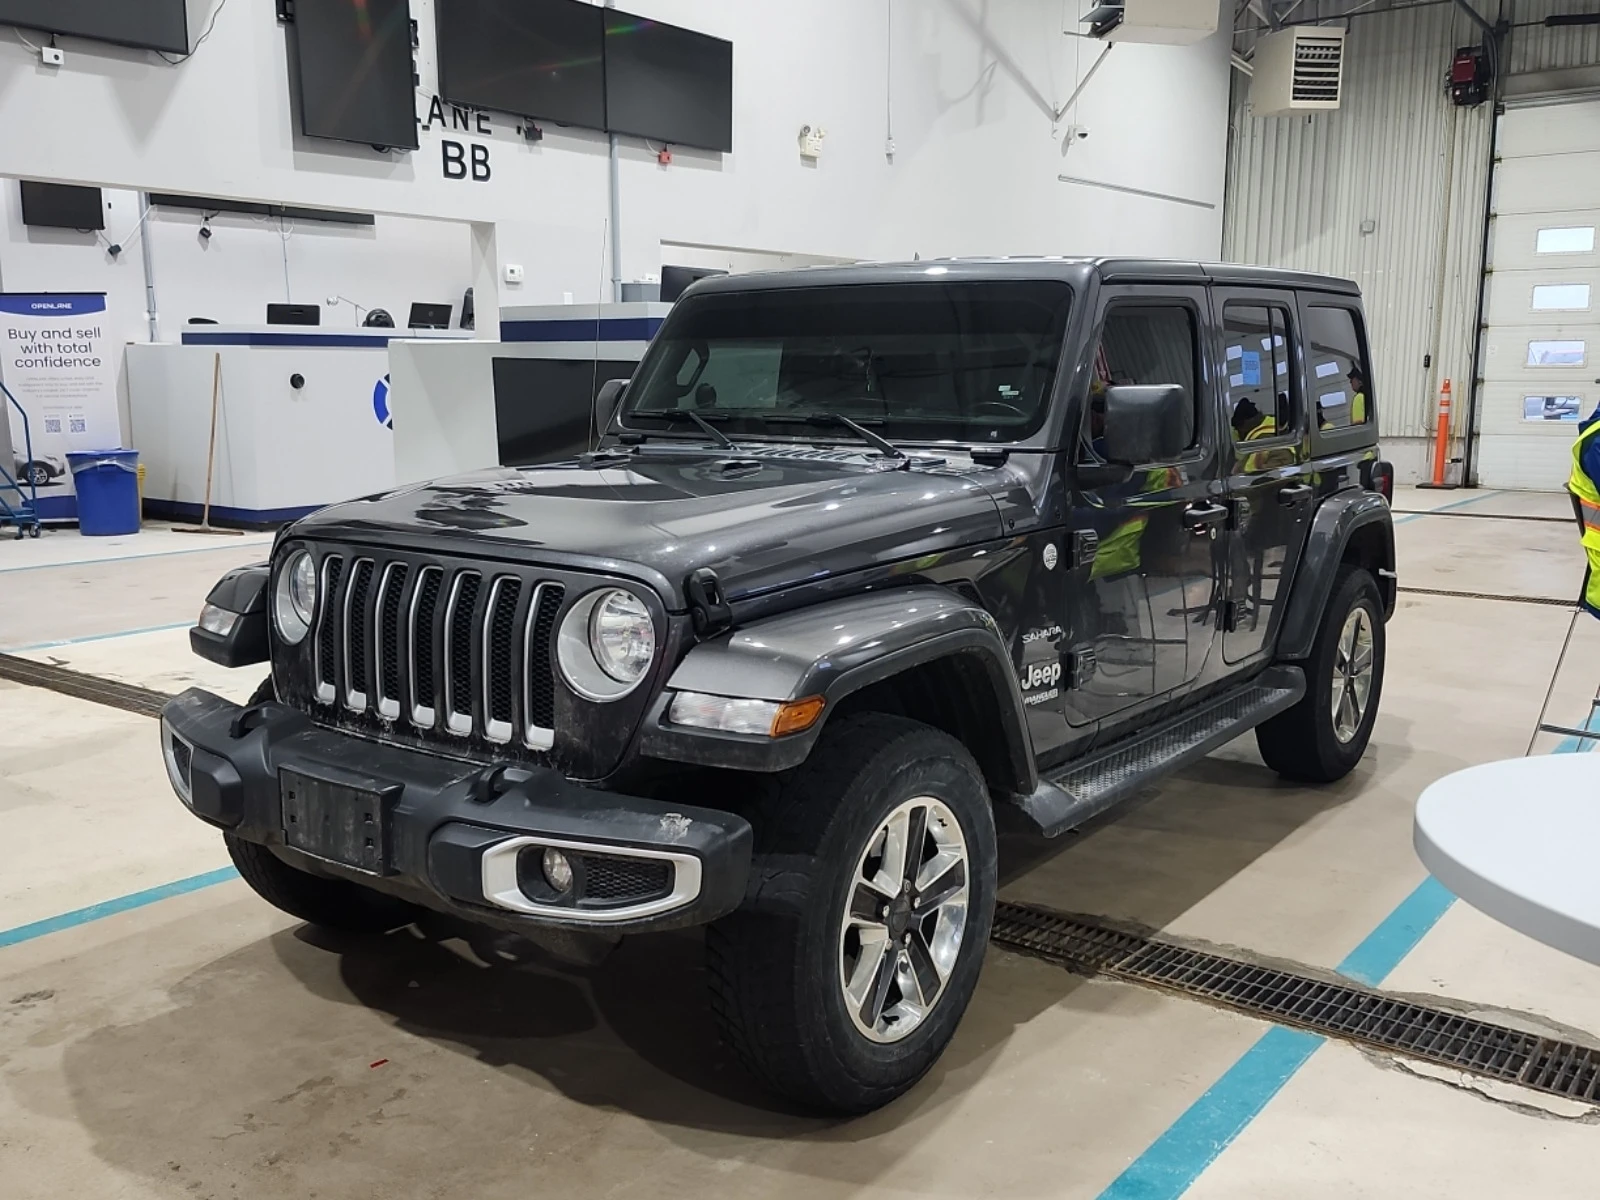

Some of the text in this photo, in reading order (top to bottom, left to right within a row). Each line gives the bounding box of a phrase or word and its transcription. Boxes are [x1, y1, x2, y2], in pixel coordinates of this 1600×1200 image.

[421, 94, 492, 135] ANE
[441, 139, 491, 182] BB
[30, 302, 73, 310] OPENLANE
[7, 326, 101, 343] Buy and sell
[20, 341, 92, 354] with total
[14, 356, 101, 368] confidence
[1022, 625, 1062, 644] SAHARA
[1021, 662, 1061, 690] Jeep
